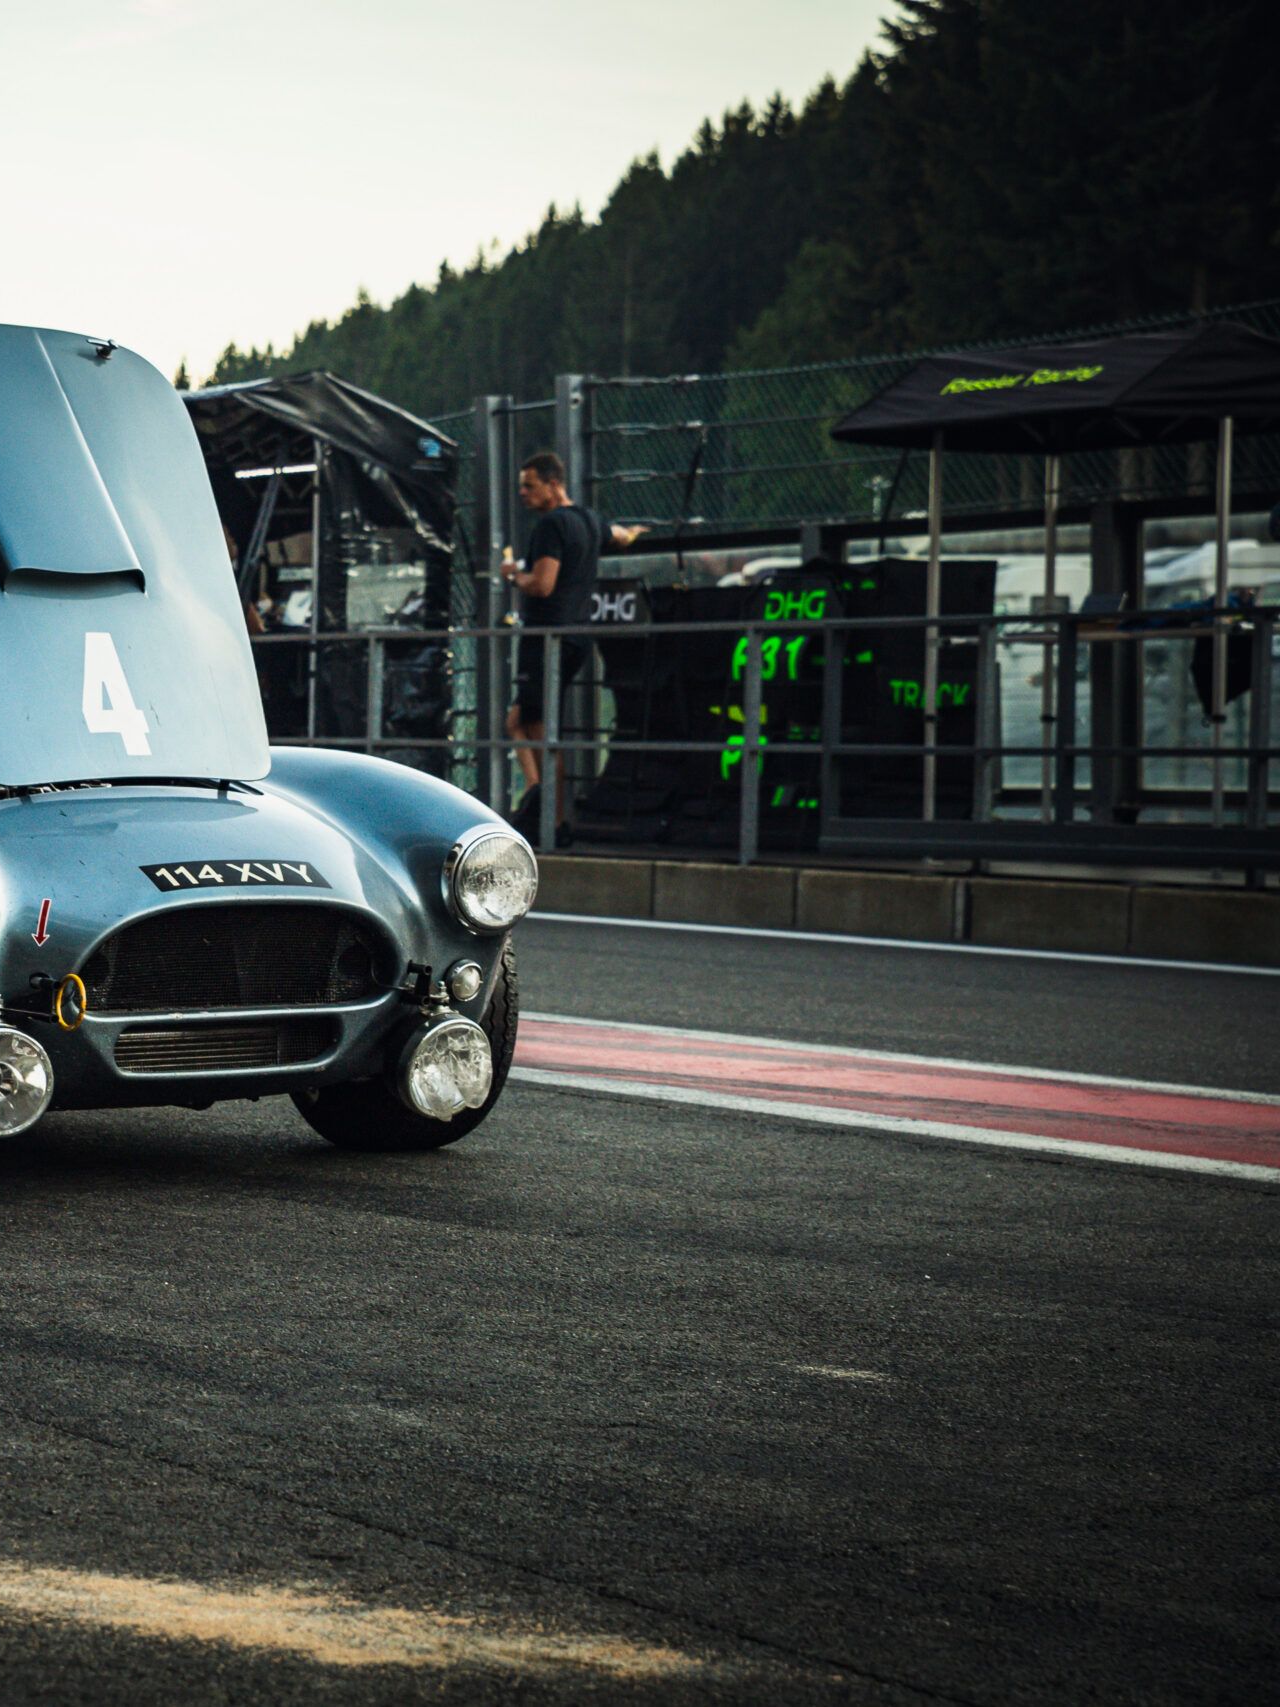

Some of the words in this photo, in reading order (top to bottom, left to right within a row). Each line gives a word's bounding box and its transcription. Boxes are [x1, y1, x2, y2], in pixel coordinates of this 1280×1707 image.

[763, 589, 827, 620] DHG
[82, 632, 152, 756] 4
[155, 863, 224, 887] 114
[225, 862, 313, 884] XVY
